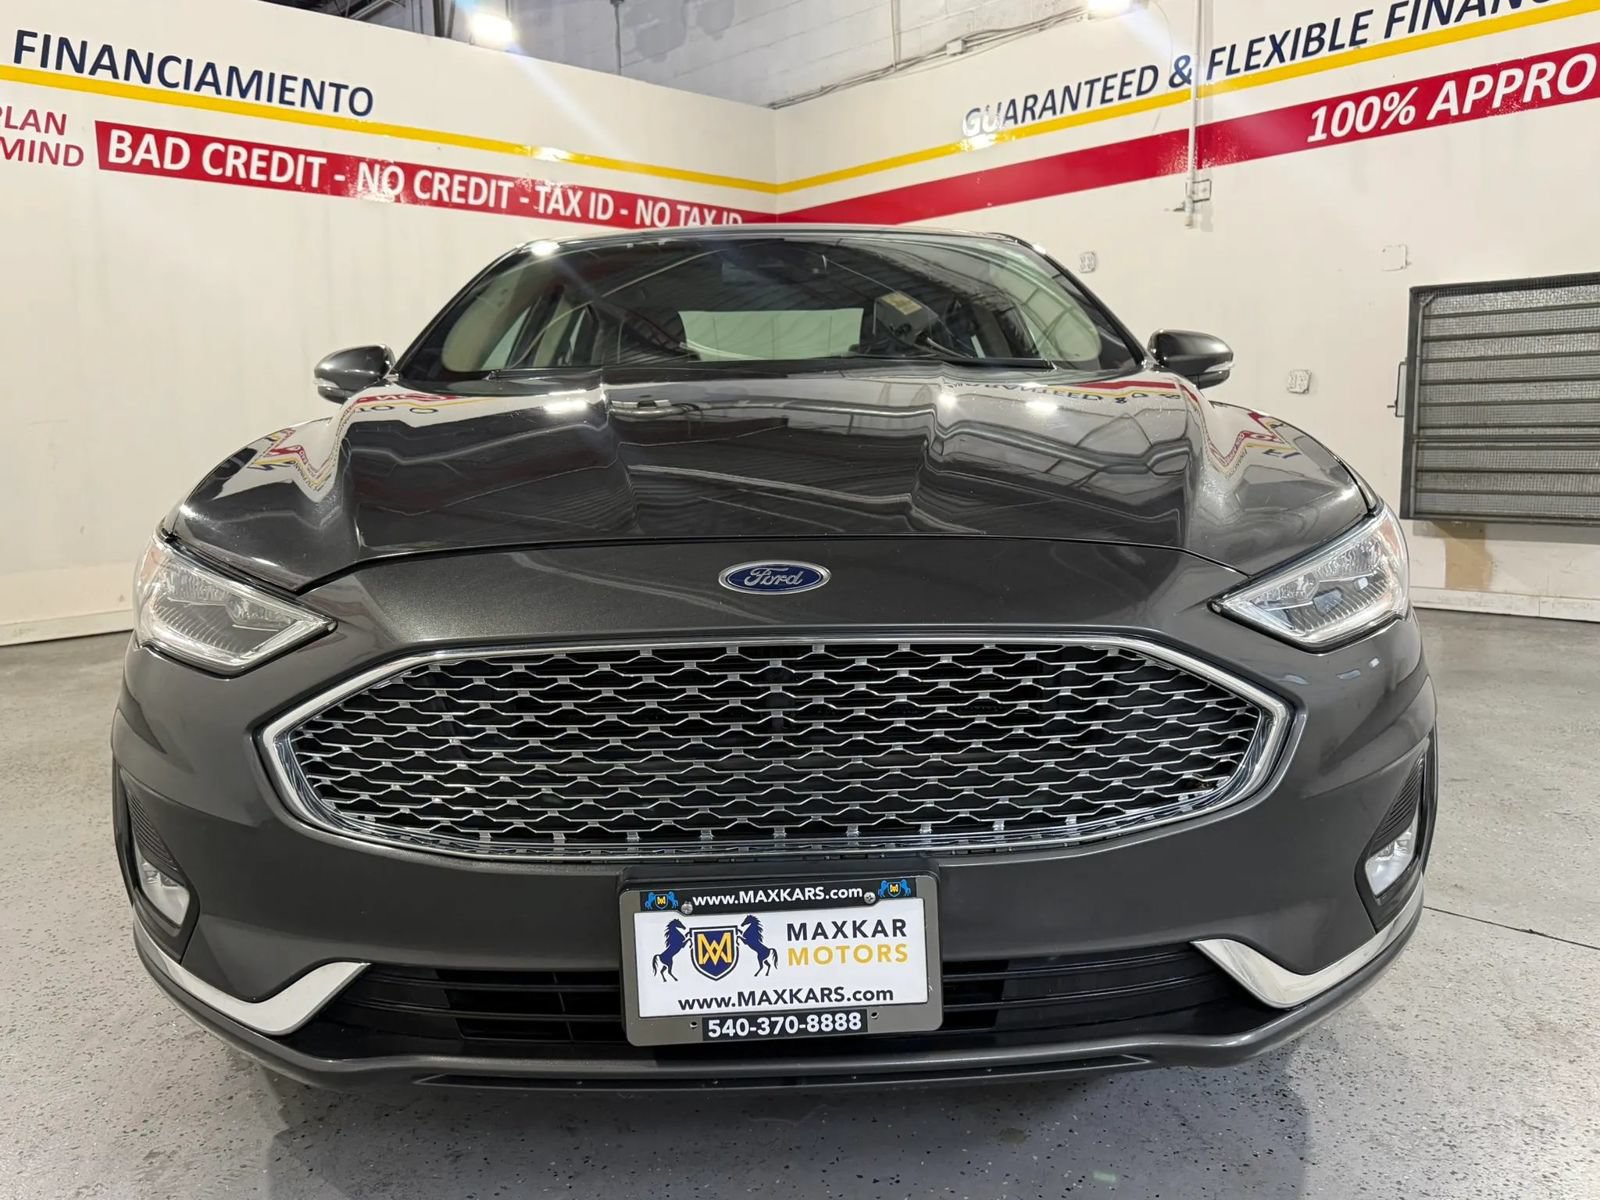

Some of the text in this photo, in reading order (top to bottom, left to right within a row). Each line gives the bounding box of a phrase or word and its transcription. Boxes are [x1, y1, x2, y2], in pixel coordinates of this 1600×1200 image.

[14, 30, 374, 117] FINANCIAMIENTO
[962, 0, 1553, 137] GUARANTEED & FLEXIBLE FINA
[1306, 53, 1598, 144] 100% APPRO
[0, 105, 67, 135] LAN
[0, 136, 84, 167] MIND
[107, 129, 191, 171] BAD
[201, 141, 328, 189] CREDIT
[357, 161, 405, 196] NO
[413, 170, 515, 209] CREDIT
[535, 185, 582, 217] TAX
[588, 195, 614, 221] ID
[635, 198, 671, 227] NO
[677, 205, 717, 227] TAX
[744, 567, 804, 586] Ford
[692, 886, 863, 907] www.MAXKARS.com
[786, 918, 907, 942] MAXKAR
[788, 943, 908, 966] MOTORS
[678, 986, 894, 1011] www.MAXKARS.com
[707, 1012, 862, 1038] 540-370-8888
